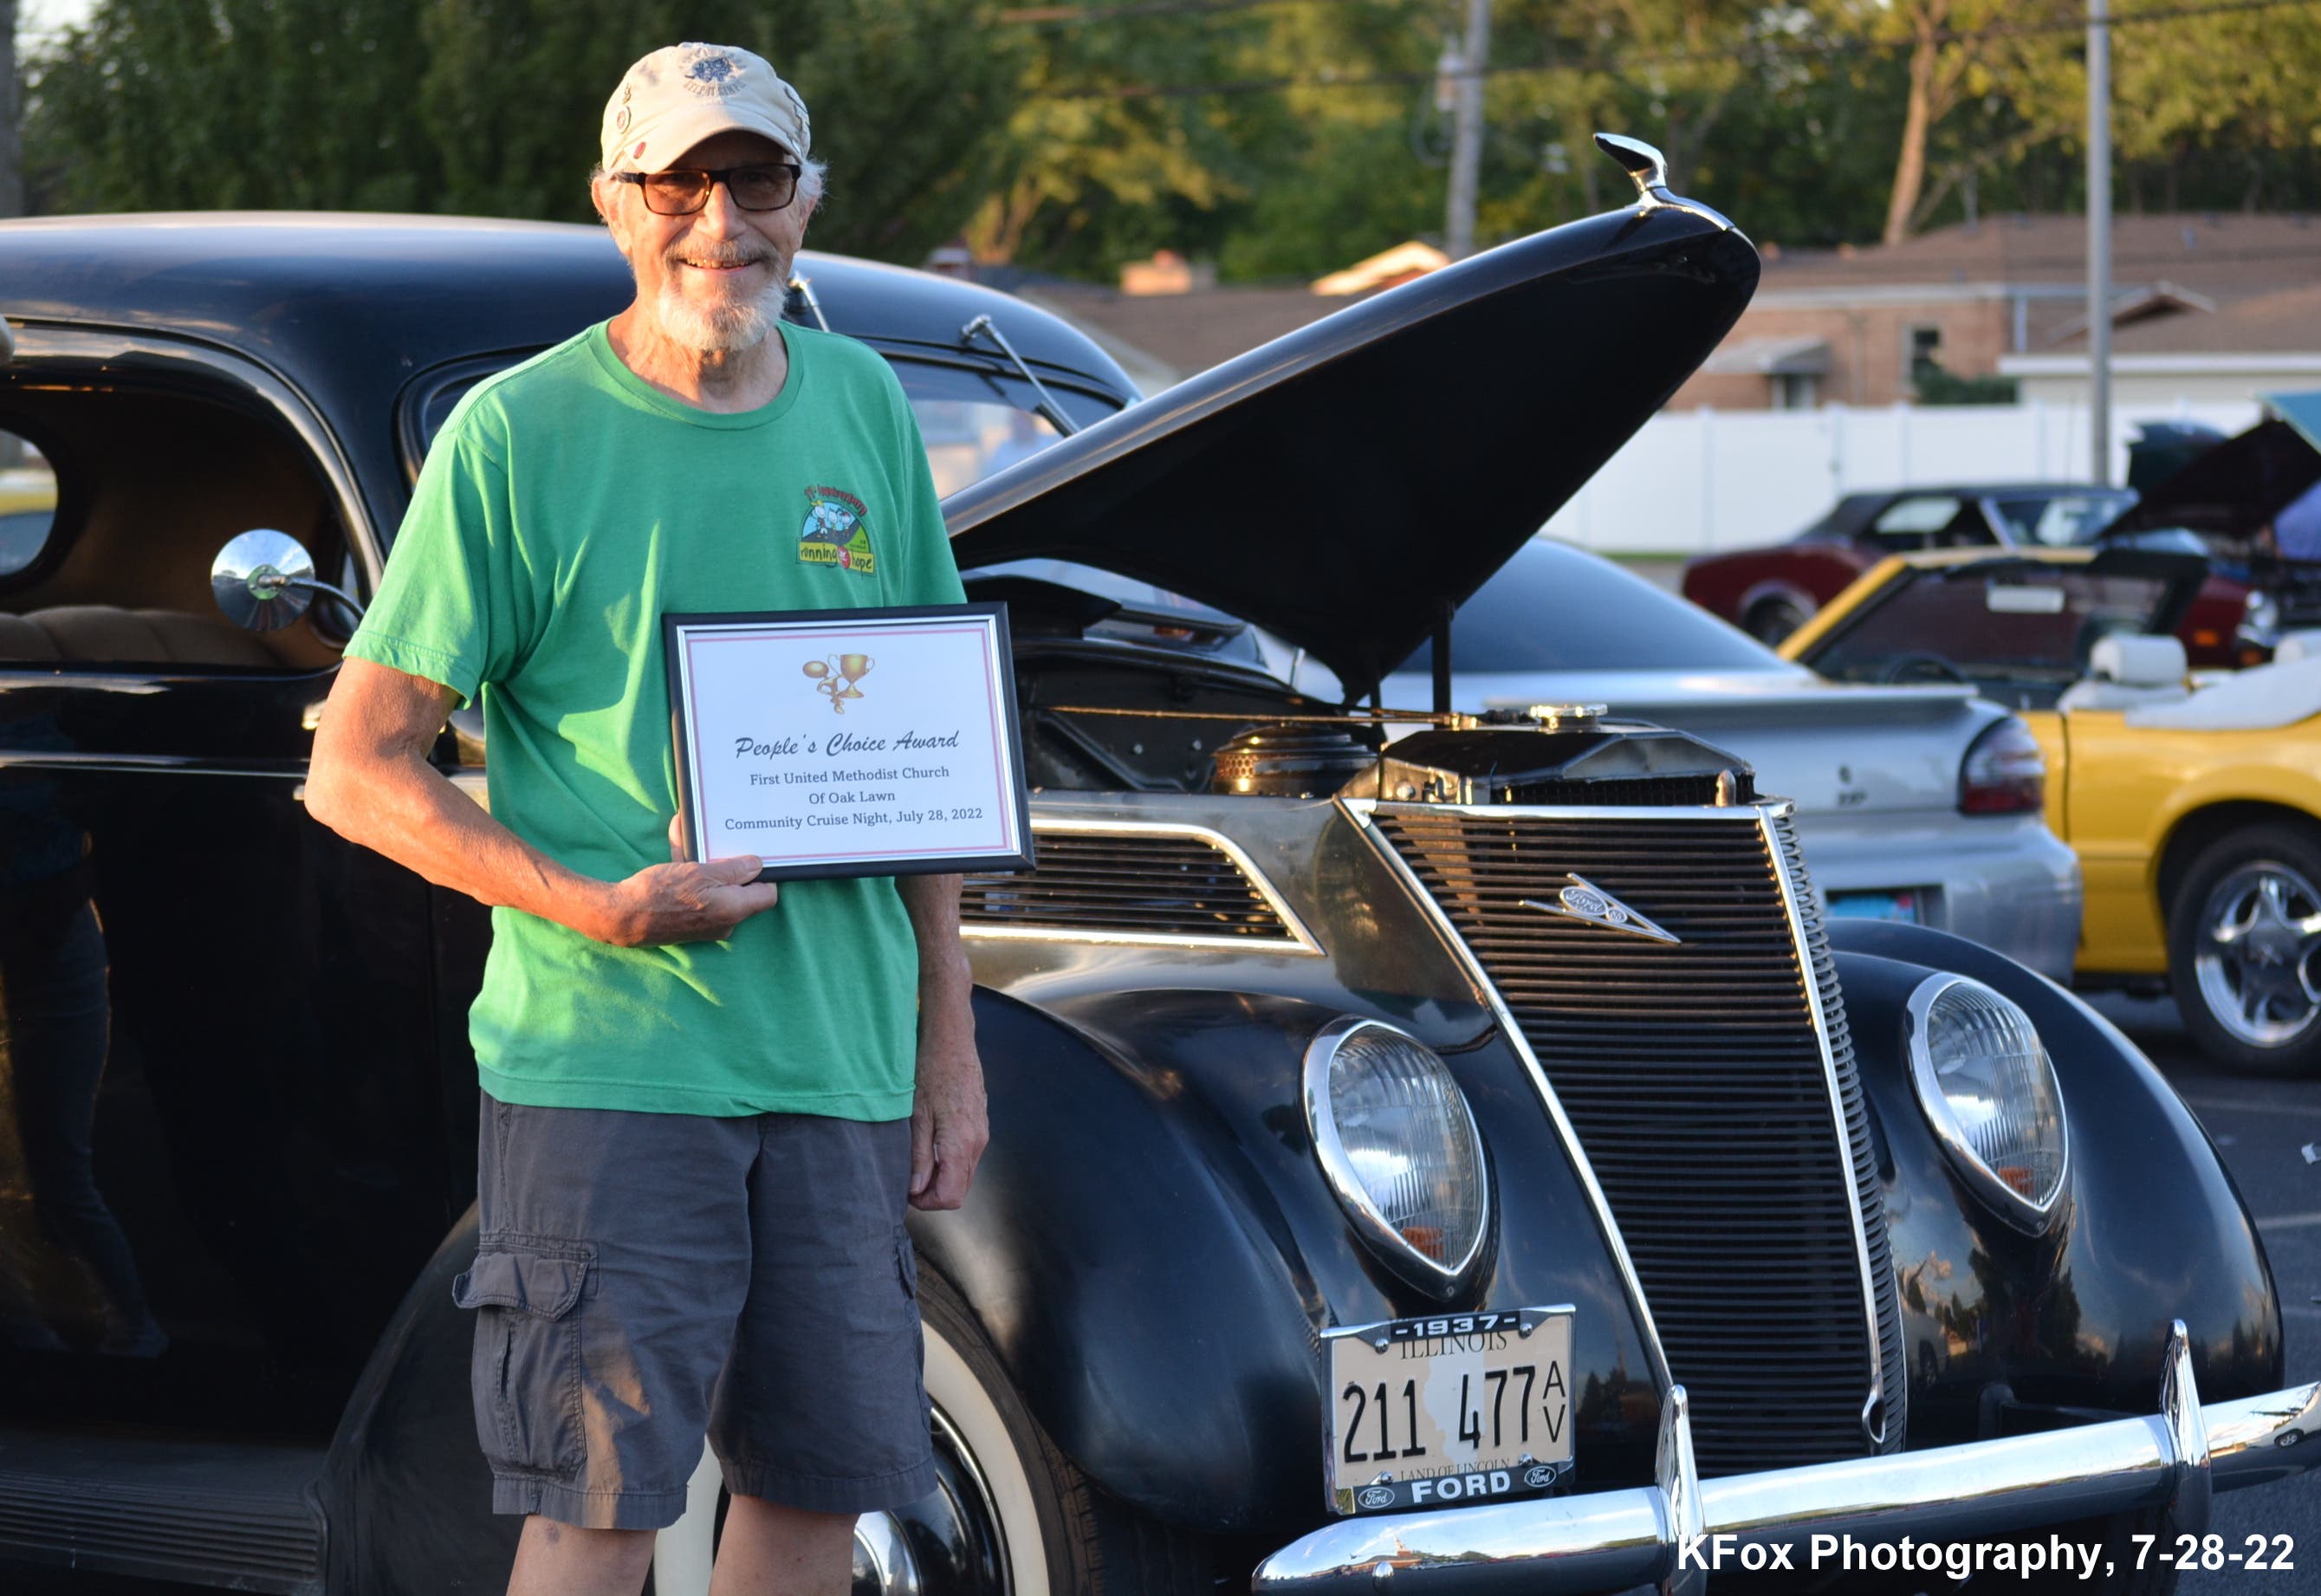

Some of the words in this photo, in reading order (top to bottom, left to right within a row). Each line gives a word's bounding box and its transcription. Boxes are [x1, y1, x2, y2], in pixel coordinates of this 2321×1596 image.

[736, 734, 818, 760] People's
[826, 732, 886, 756] Choice
[892, 730, 960, 751] Award
[750, 773, 781, 786] First
[784, 771, 828, 784] United
[832, 769, 898, 782] Methodist
[902, 766, 950, 779] Church
[808, 792, 826, 805] Of
[828, 791, 856, 804] Oak
[859, 790, 896, 802] Lawn
[724, 816, 802, 830] Community
[807, 814, 849, 827] Cruise
[853, 812, 892, 827] Night,
[896, 810, 924, 824] July
[928, 809, 948, 822] 28,
[951, 808, 983, 821] 2022
[1400, 1331, 1507, 1359] ILLINOIS
[1343, 1379, 1426, 1463] 211
[1459, 1365, 1536, 1450] 477
[1400, 1468, 1435, 1482] LAND
[1438, 1465, 1454, 1476] OF
[1530, 1469, 1551, 1483] Ford
[1365, 1489, 1388, 1505] Ford
[1411, 1471, 1511, 1503] FORD
